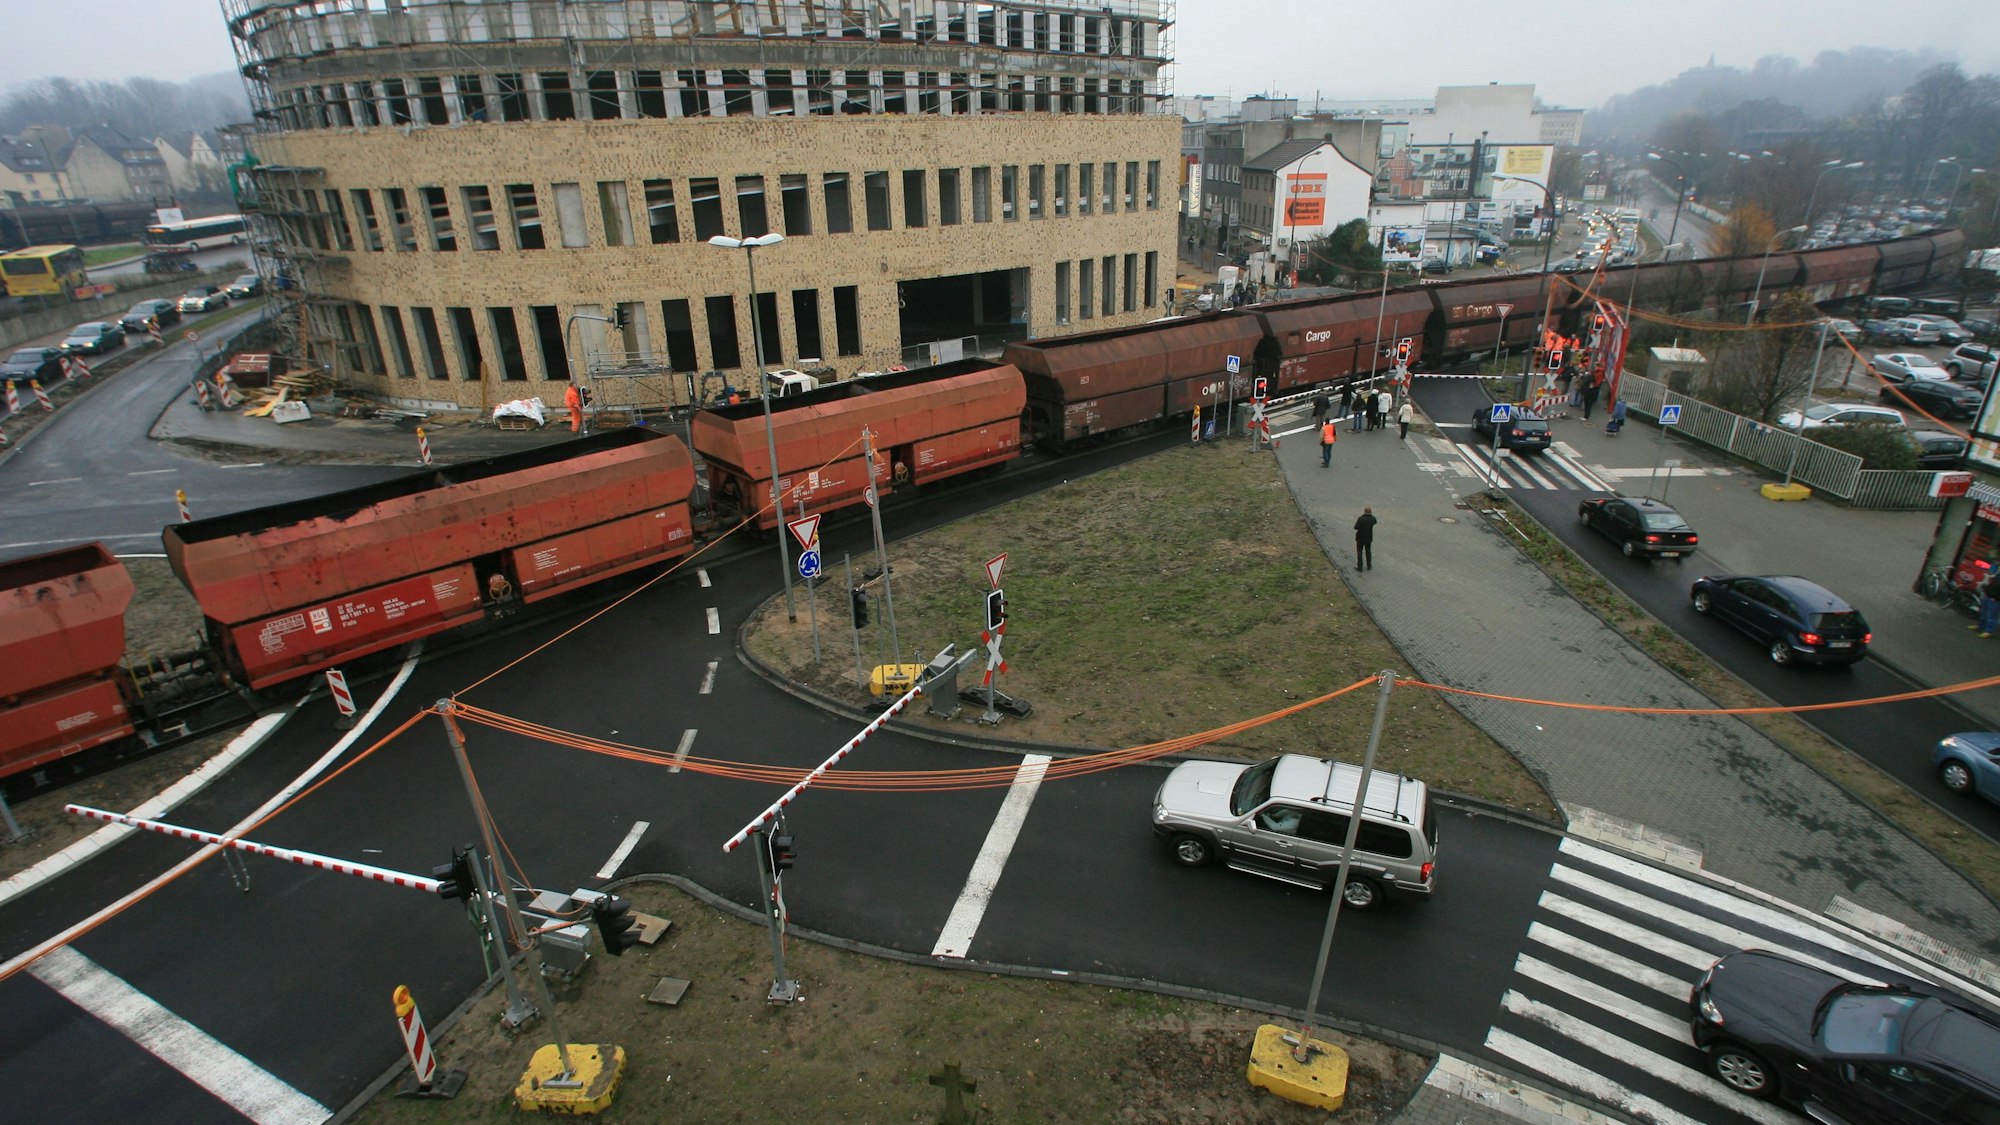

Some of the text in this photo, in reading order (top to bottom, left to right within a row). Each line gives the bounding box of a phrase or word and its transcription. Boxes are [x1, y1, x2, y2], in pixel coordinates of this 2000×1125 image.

[1290, 184, 1322, 193] OBI
[1467, 304, 1492, 317] Cargo
[1306, 330, 1331, 342] Cargo
[312, 611, 326, 620] HGK
